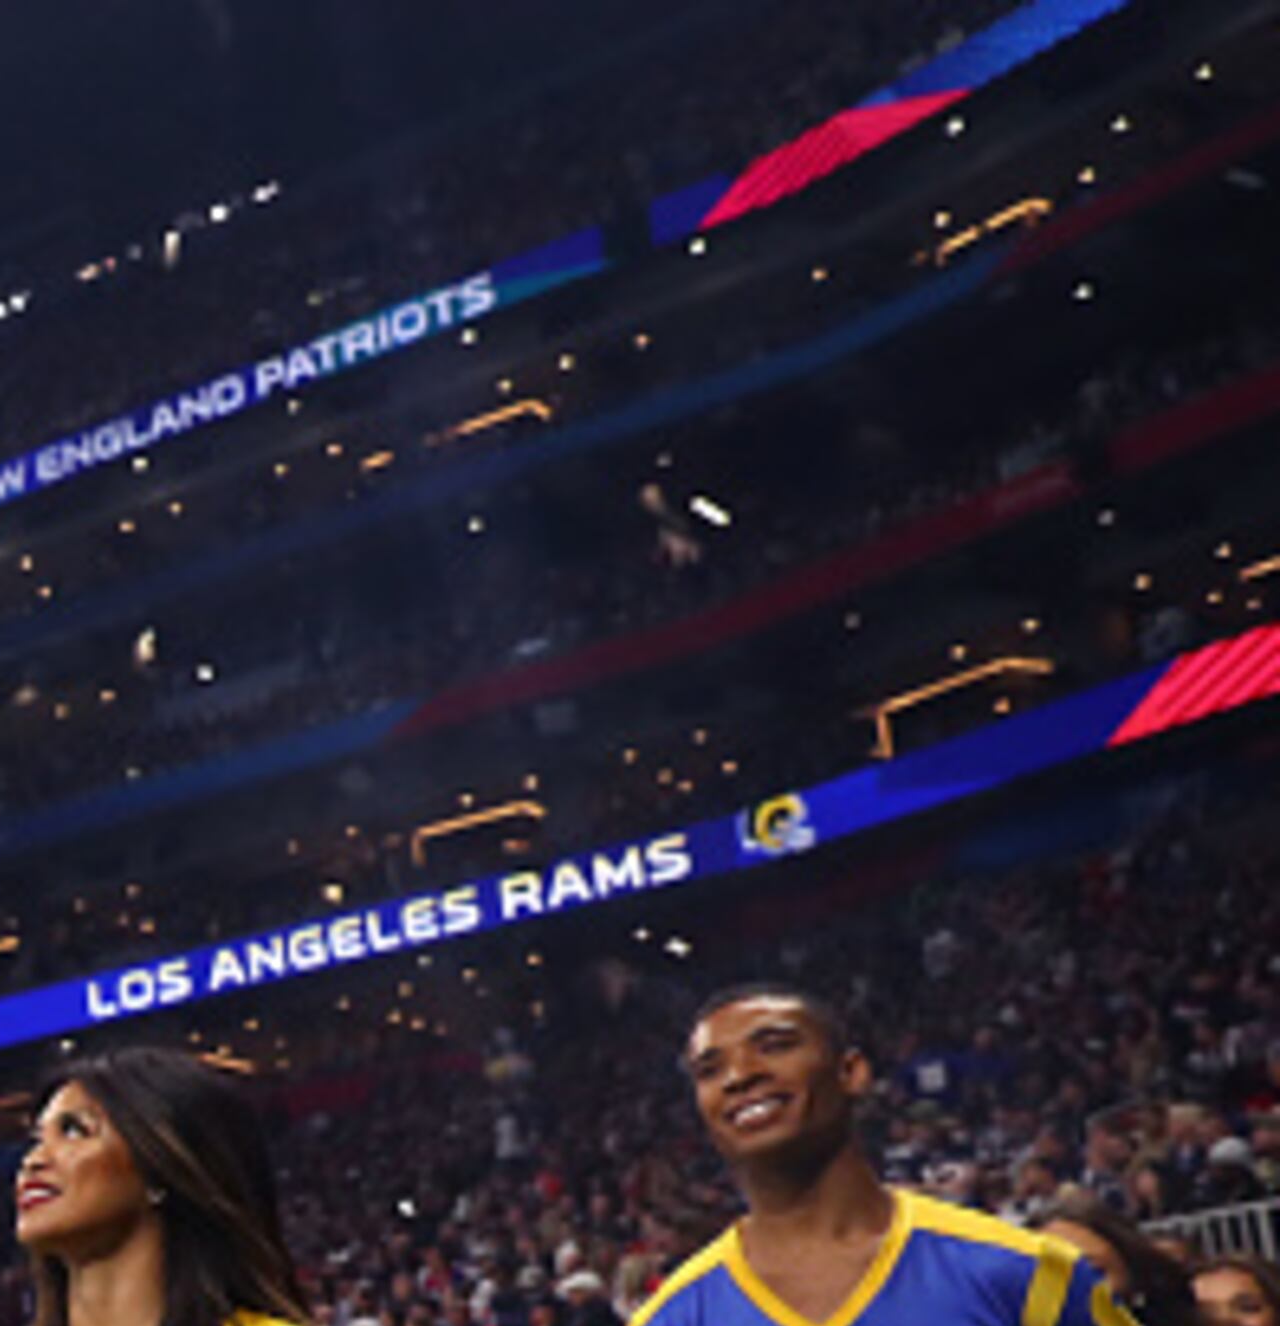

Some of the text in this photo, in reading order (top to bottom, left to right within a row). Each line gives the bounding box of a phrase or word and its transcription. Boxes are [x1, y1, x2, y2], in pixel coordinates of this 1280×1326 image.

[36, 374, 245, 481] ENGLAND
[255, 271, 497, 397] PATRIOTS
[86, 834, 691, 1017] LOS ANGELES RAMS
